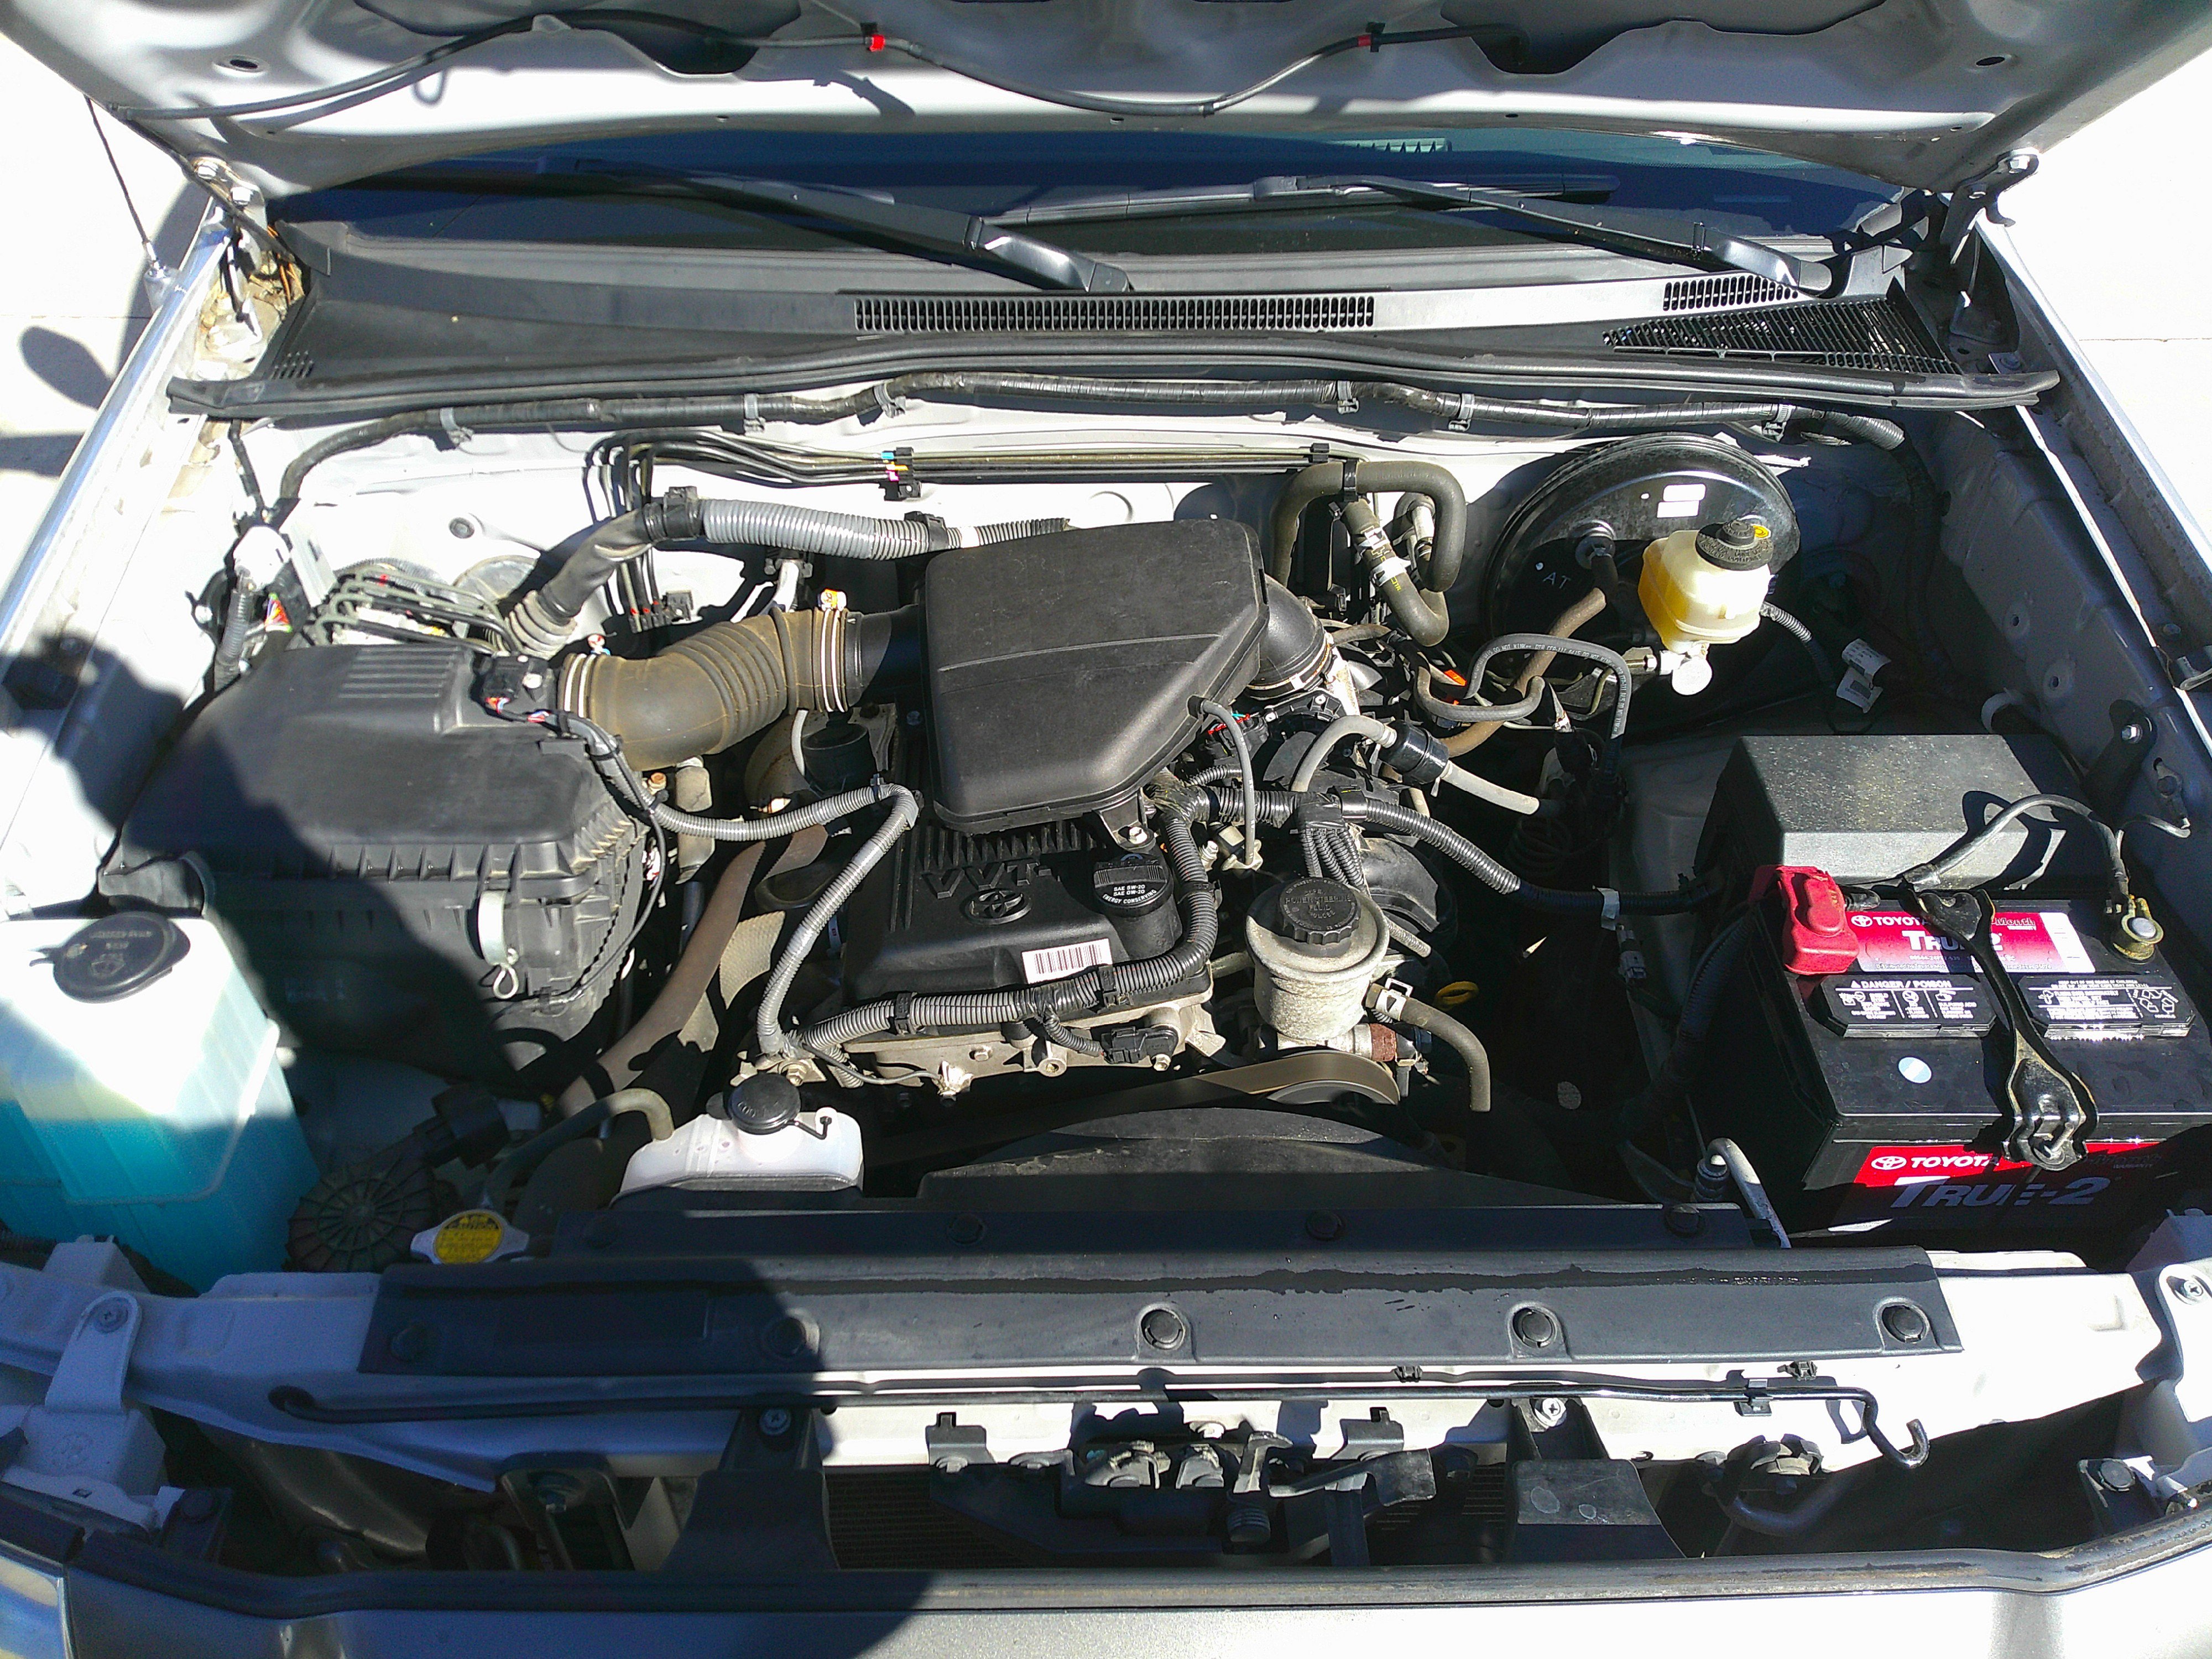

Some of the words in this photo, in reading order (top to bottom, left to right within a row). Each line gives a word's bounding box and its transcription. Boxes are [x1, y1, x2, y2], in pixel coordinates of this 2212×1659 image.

[1102, 894, 1122, 904] ENERGY
[1123, 889, 1157, 904] CONSERVING
[1860, 980, 1905, 988] DANGER
[1912, 980, 1952, 988] POISON
[1910, 1156, 1999, 1168] TOYOTA
